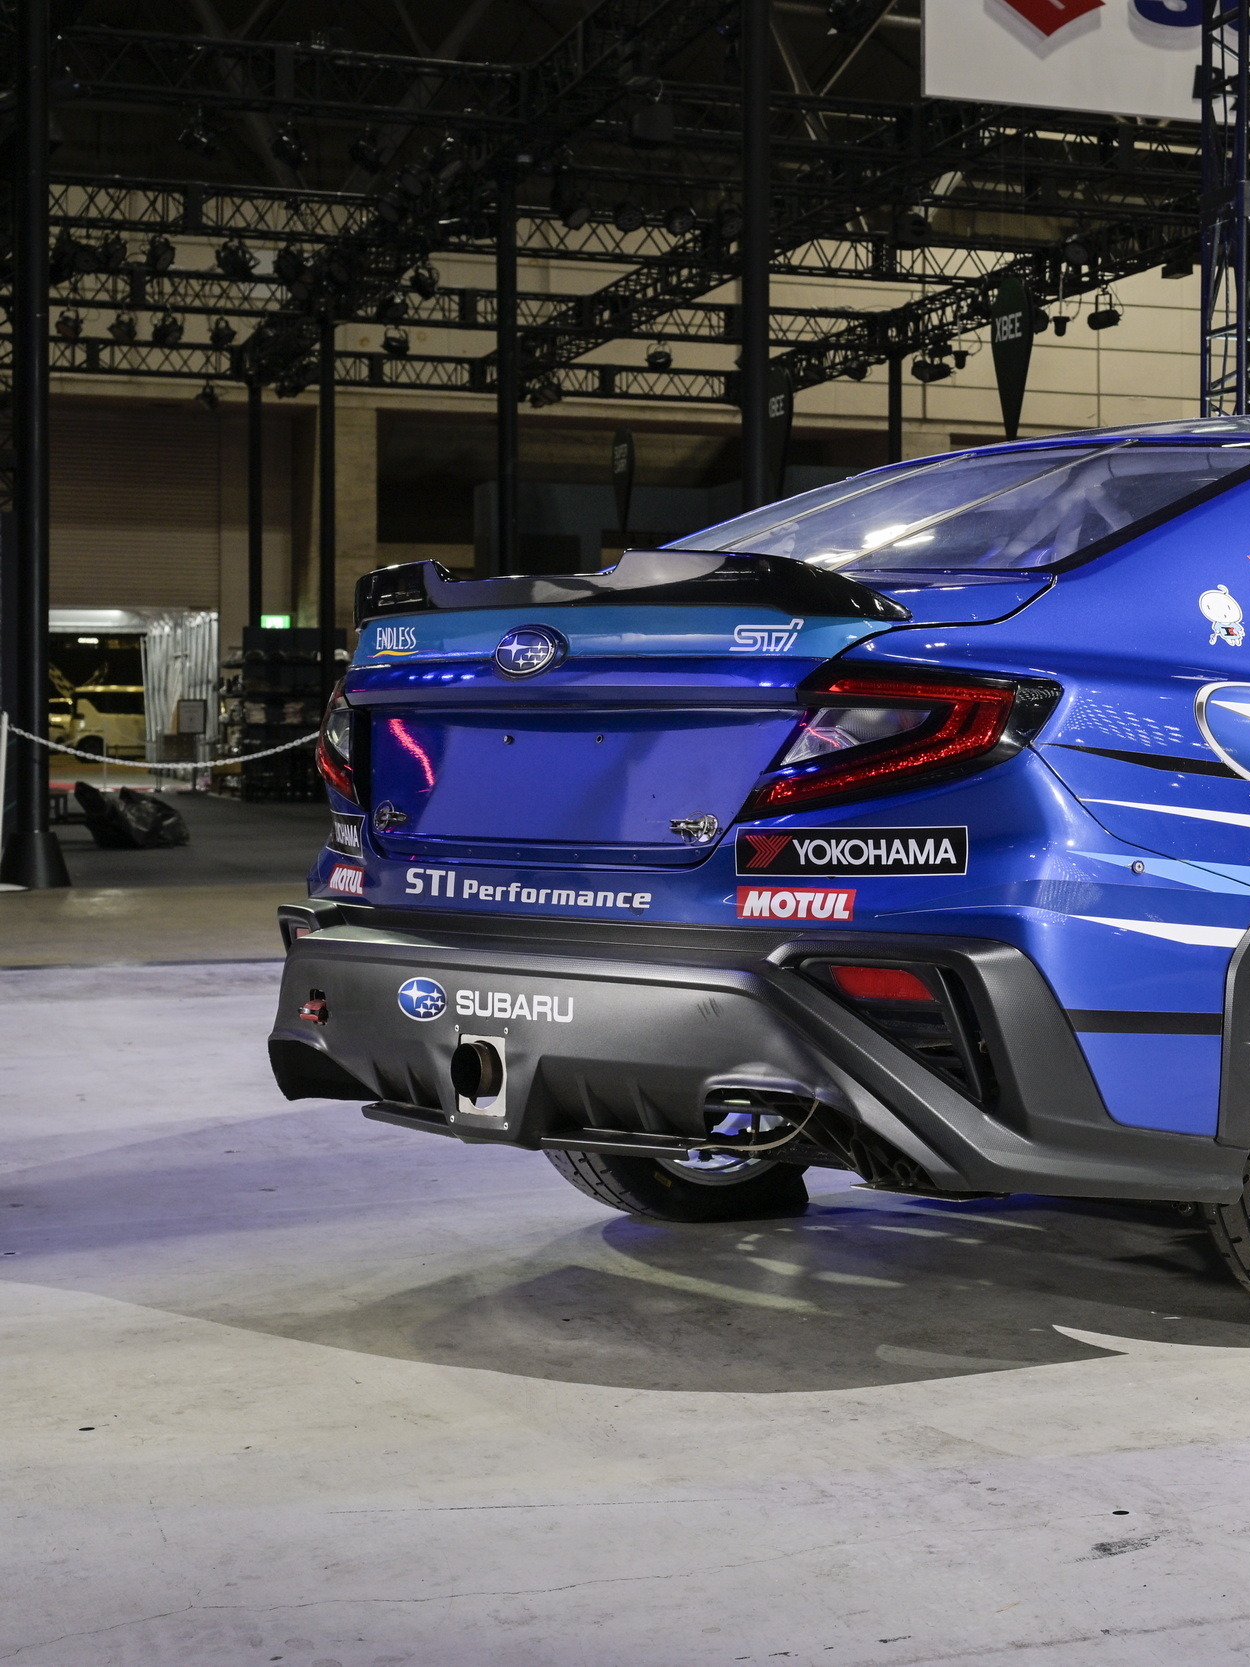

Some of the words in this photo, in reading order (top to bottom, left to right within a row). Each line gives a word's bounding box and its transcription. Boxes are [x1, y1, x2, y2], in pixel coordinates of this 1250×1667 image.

[994, 312, 1022, 343] XBEE
[768, 394, 785, 418] BEE
[375, 626, 417, 651] ENDLESS
[792, 838, 958, 865] YOKOHAMA
[329, 867, 363, 895] MOTUL
[405, 867, 456, 898] STI
[462, 879, 652, 909] Performance
[742, 890, 850, 919] MOTUL
[455, 989, 575, 1023] SUBARU
